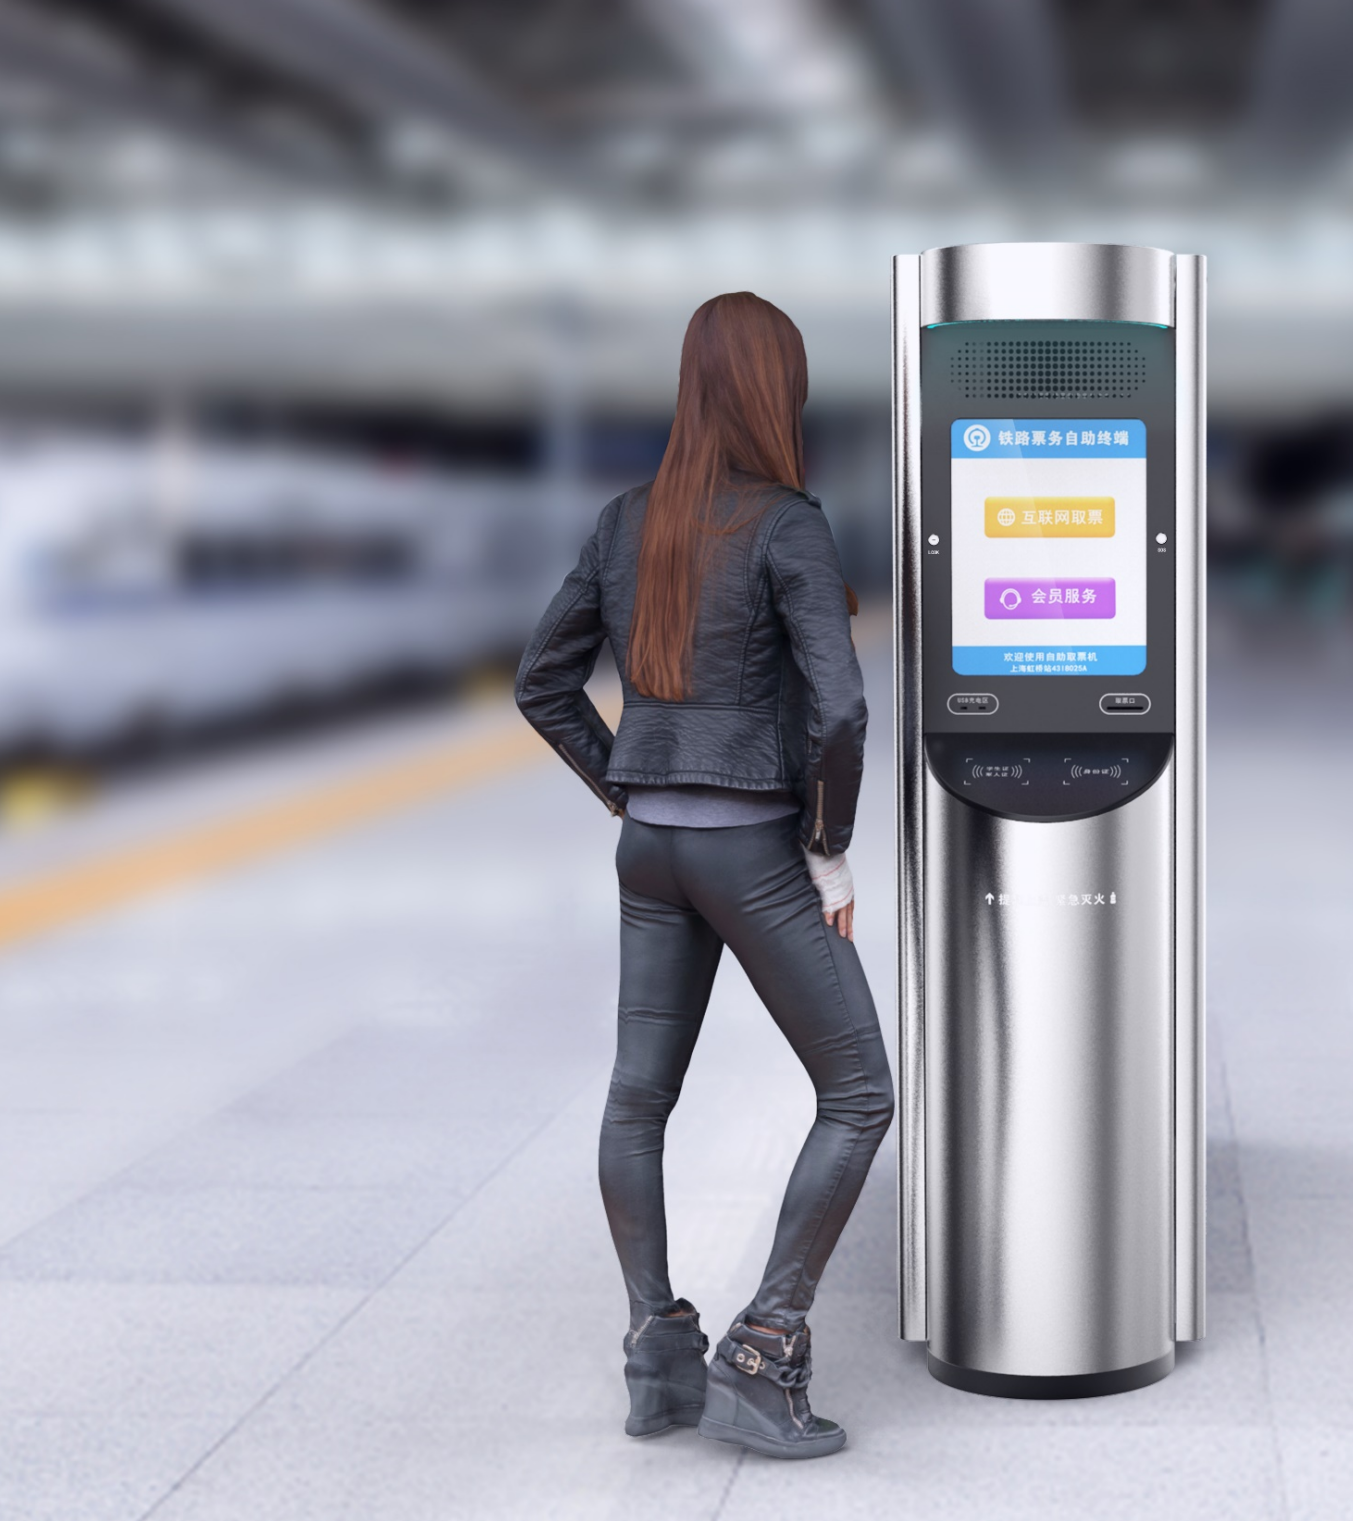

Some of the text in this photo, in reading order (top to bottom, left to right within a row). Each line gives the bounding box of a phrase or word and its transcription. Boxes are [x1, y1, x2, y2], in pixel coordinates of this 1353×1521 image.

[998, 430, 1129, 446] 铁路票务自助终端
[1021, 509, 1103, 525] 互联网取票
[1031, 588, 1097, 604] 会员服务
[1003, 652, 1098, 662] 欢迎使用自助取票机
